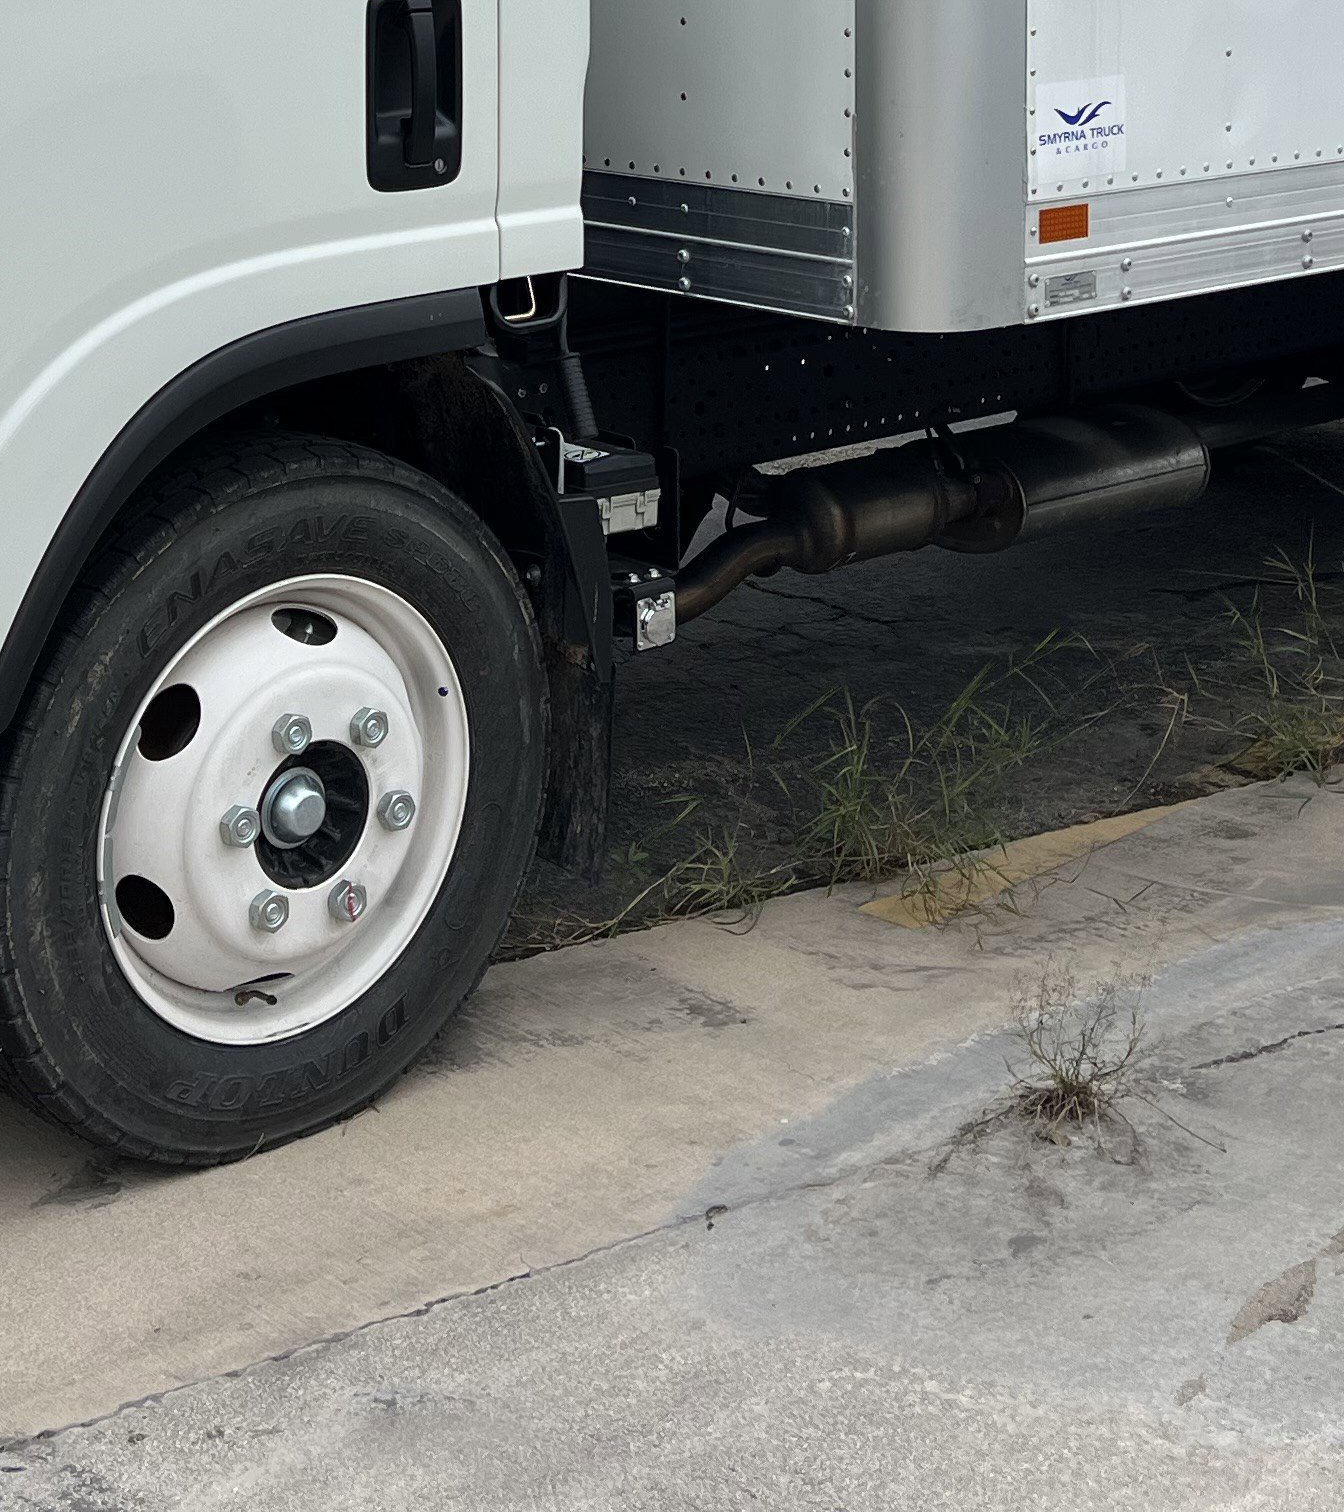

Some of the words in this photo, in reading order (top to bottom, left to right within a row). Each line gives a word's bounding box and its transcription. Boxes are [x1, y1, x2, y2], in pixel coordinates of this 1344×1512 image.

[1038, 128, 1087, 146] SMYRNA
[1090, 123, 1125, 139] TRUCK
[1065, 140, 1109, 154] CARGO
[163, 992, 410, 1112] DUNLOP
